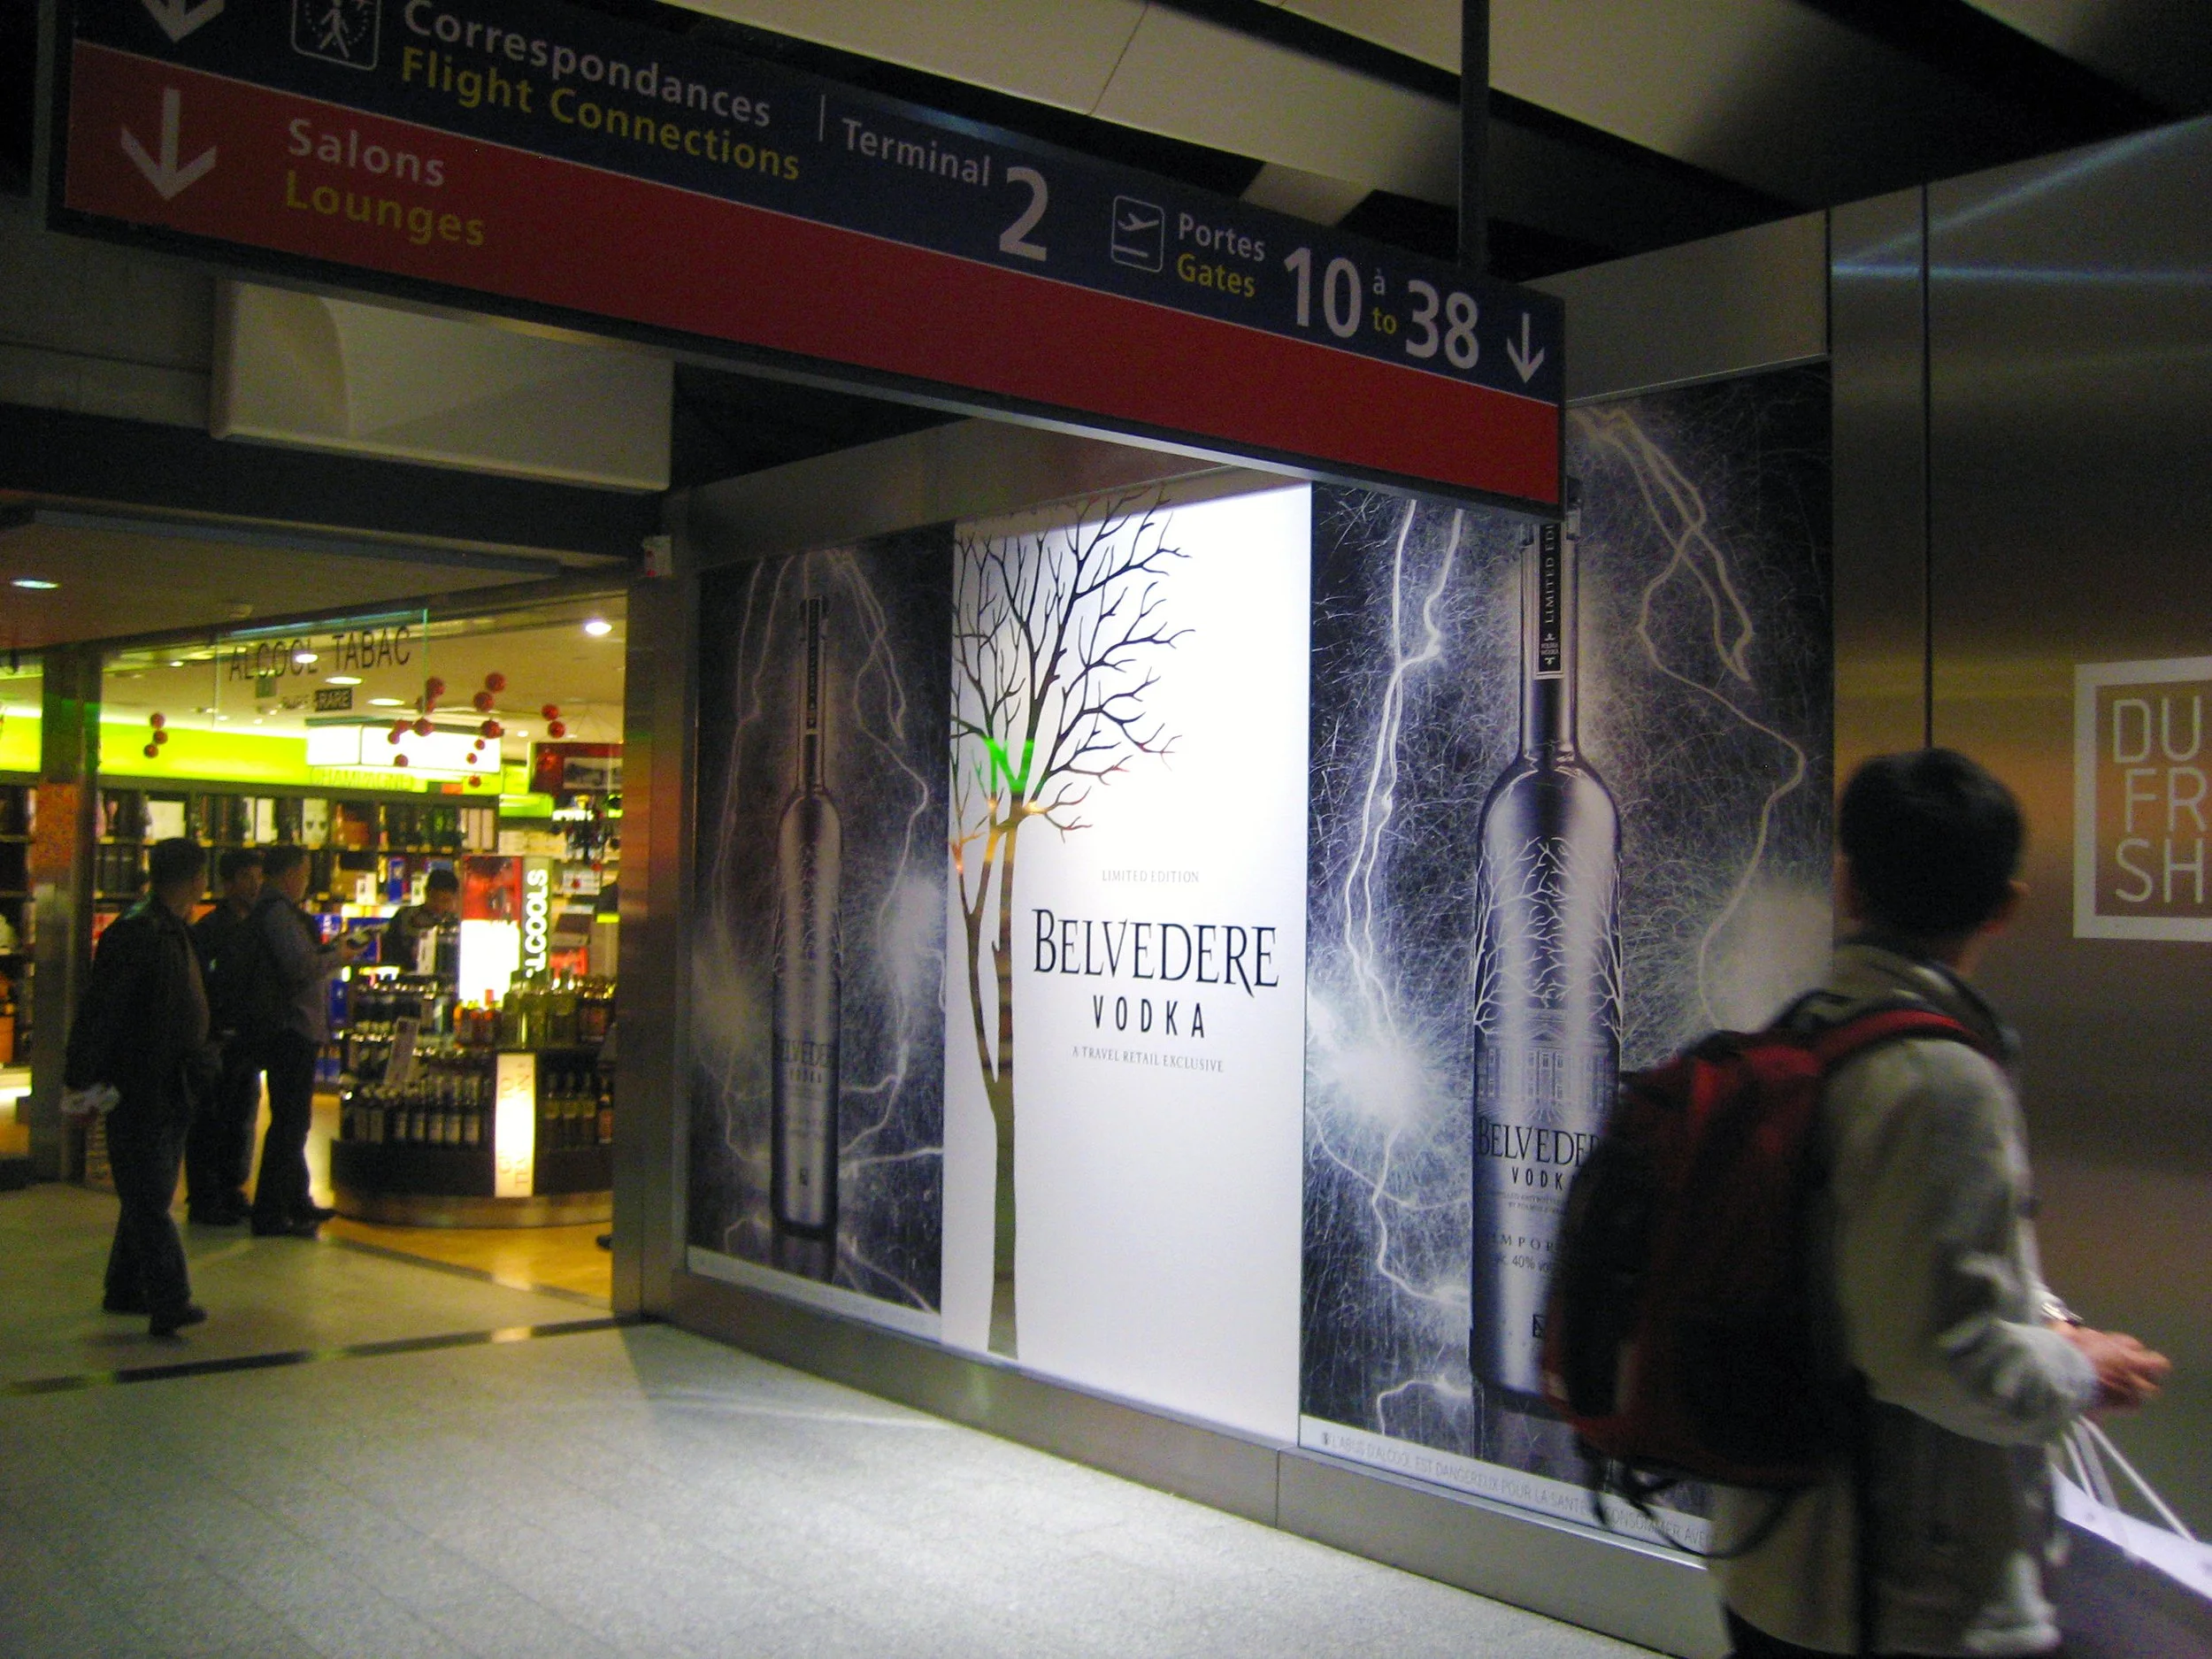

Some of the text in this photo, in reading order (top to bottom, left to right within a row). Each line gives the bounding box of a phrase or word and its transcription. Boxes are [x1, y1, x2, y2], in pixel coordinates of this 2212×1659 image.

[403, 0, 772, 128] Correspondances
[402, 47, 801, 181] Flight Connections
[287, 117, 446, 188] Salons
[284, 170, 486, 247] Lounges
[842, 118, 1049, 263] Terminal 2
[1176, 251, 1398, 335] Gates to
[1177, 212, 1480, 370] Portes 10 à 38
[1544, 524, 1555, 625] EDI LIMITED
[332, 624, 412, 672] TABAC
[2113, 695, 2202, 764] DU
[2125, 766, 2208, 833] FR
[1101, 869, 1200, 884] LIMITED EDITION
[2115, 838, 2204, 905] SH
[525, 869, 549, 979] LCOOLS
[1032, 908, 1280, 999] BELVEDERE
[1092, 994, 1205, 1039] VODKA
[1071, 1045, 1225, 1073] A TRAVEL RETAIL EXCLUSIVE
[1476, 1115, 1600, 1169] BELVEDE
[1510, 1166, 1567, 1192] VODK
[1491, 1232, 1555, 1252] IMPOR
[1511, 1255, 1536, 1271] 40%
[1501, 1478, 1531, 1500] POUR
[1535, 1489, 1548, 1504] LA
[1685, 1527, 1708, 1548] AVE
